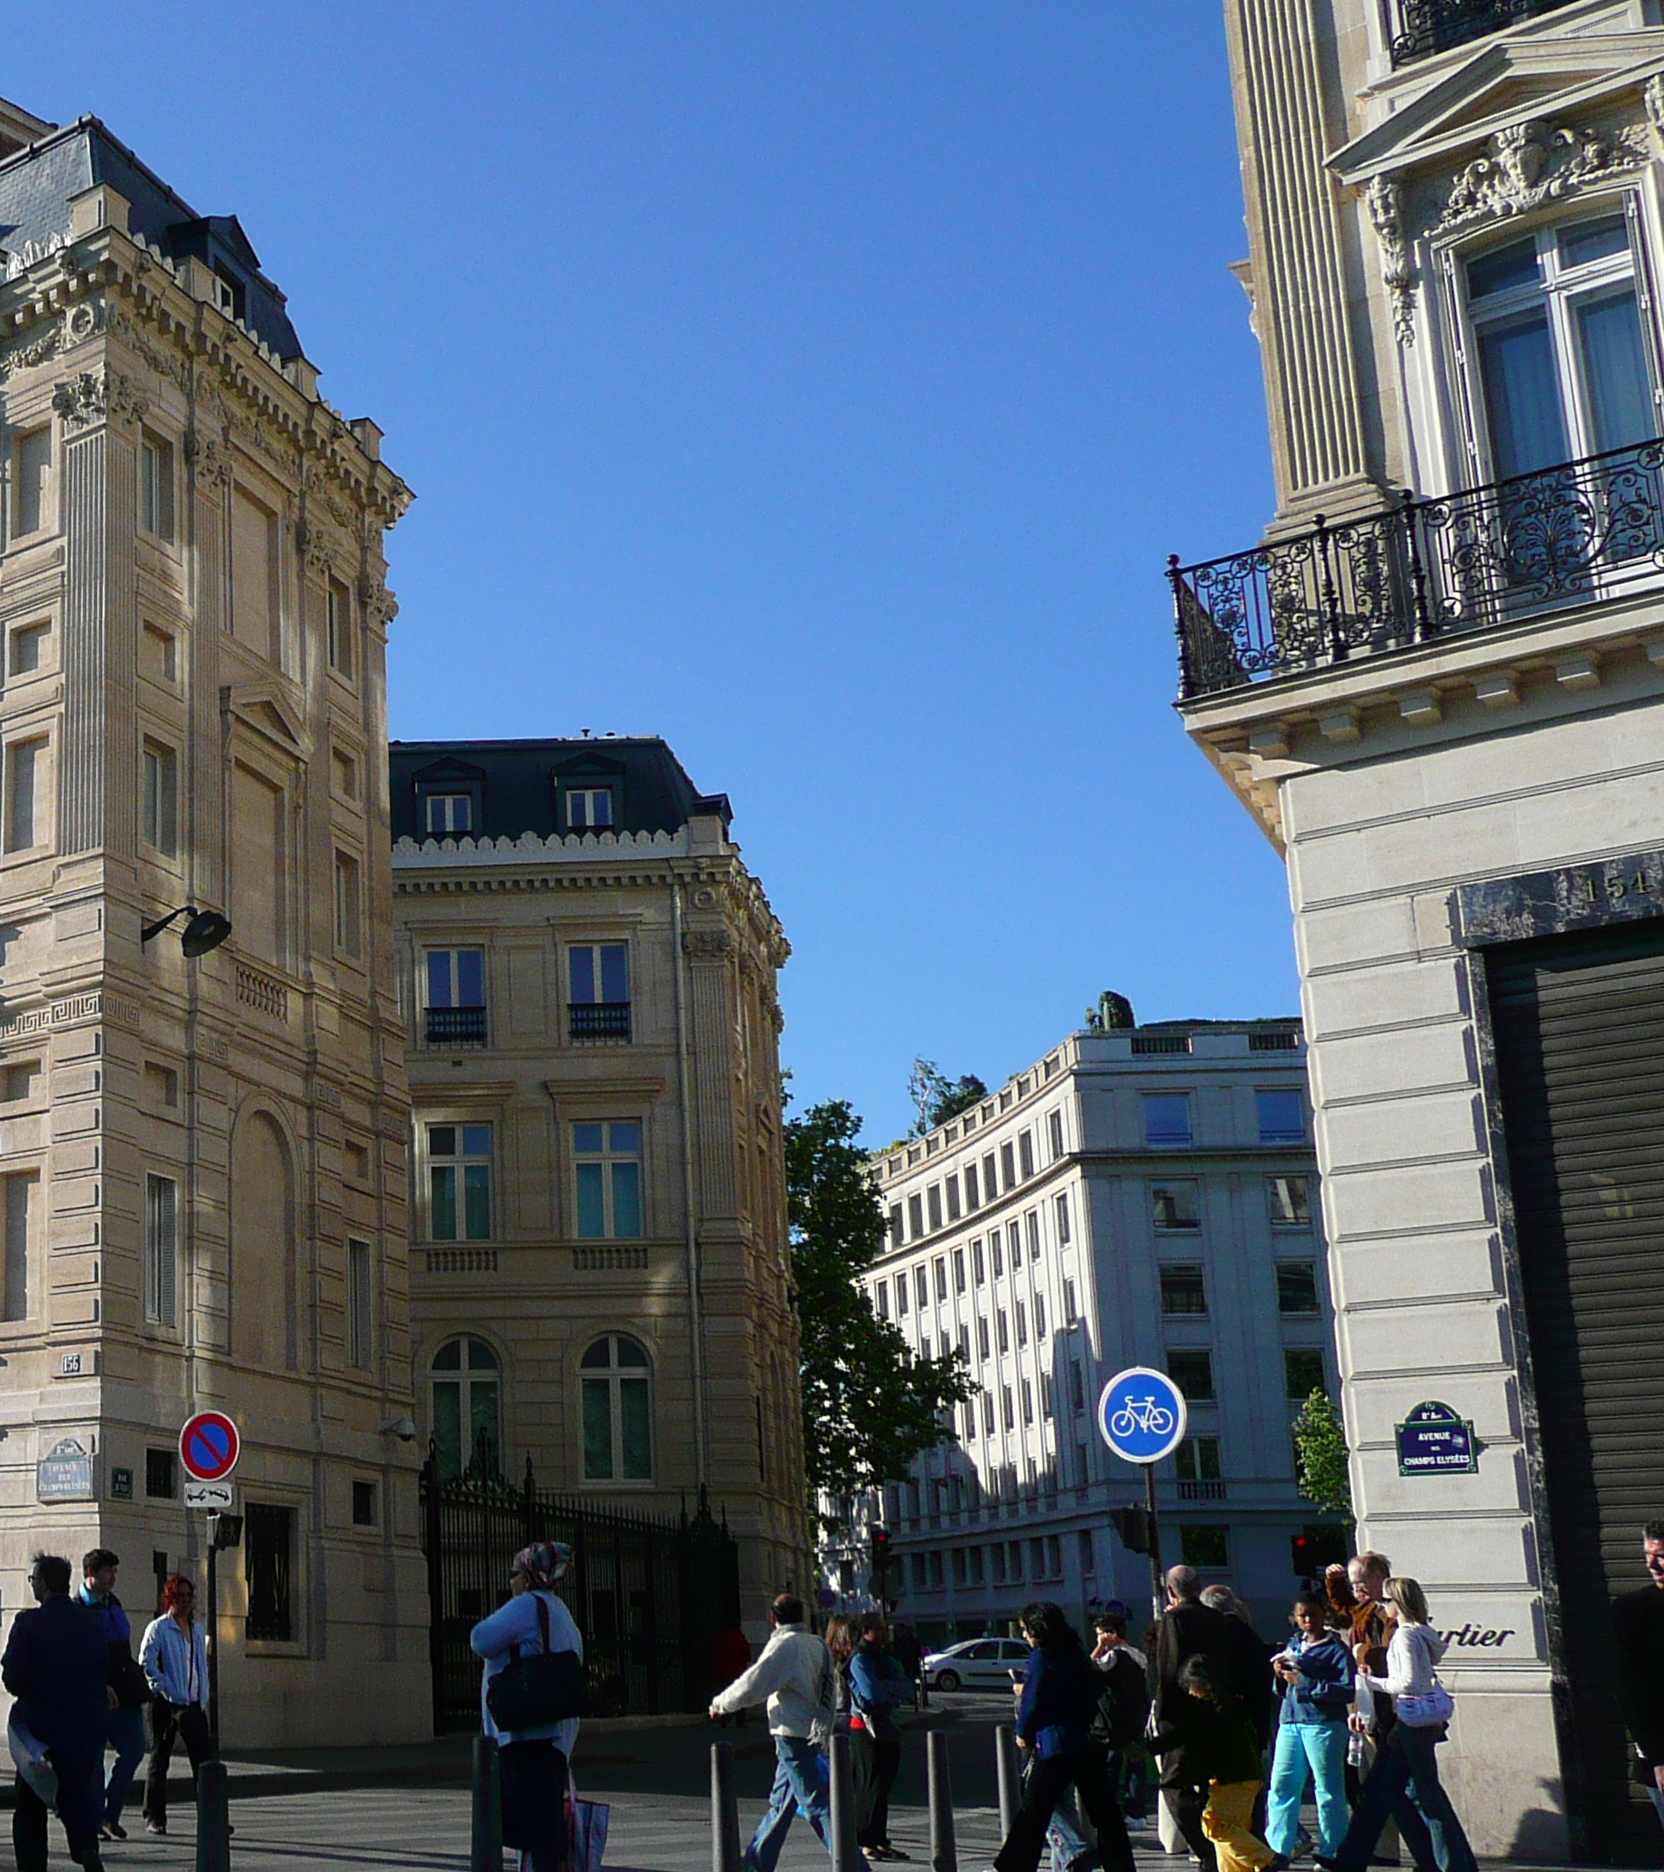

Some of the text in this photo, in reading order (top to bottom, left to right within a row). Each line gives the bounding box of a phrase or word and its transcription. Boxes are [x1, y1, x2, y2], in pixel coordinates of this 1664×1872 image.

[1586, 871, 1656, 903] 154
[64, 1356, 79, 1371] 156
[1418, 1432, 1450, 1441] AVENUE
[1404, 1457, 1435, 1466] CHAMPS
[1428, 1617, 1515, 1647] rtier
